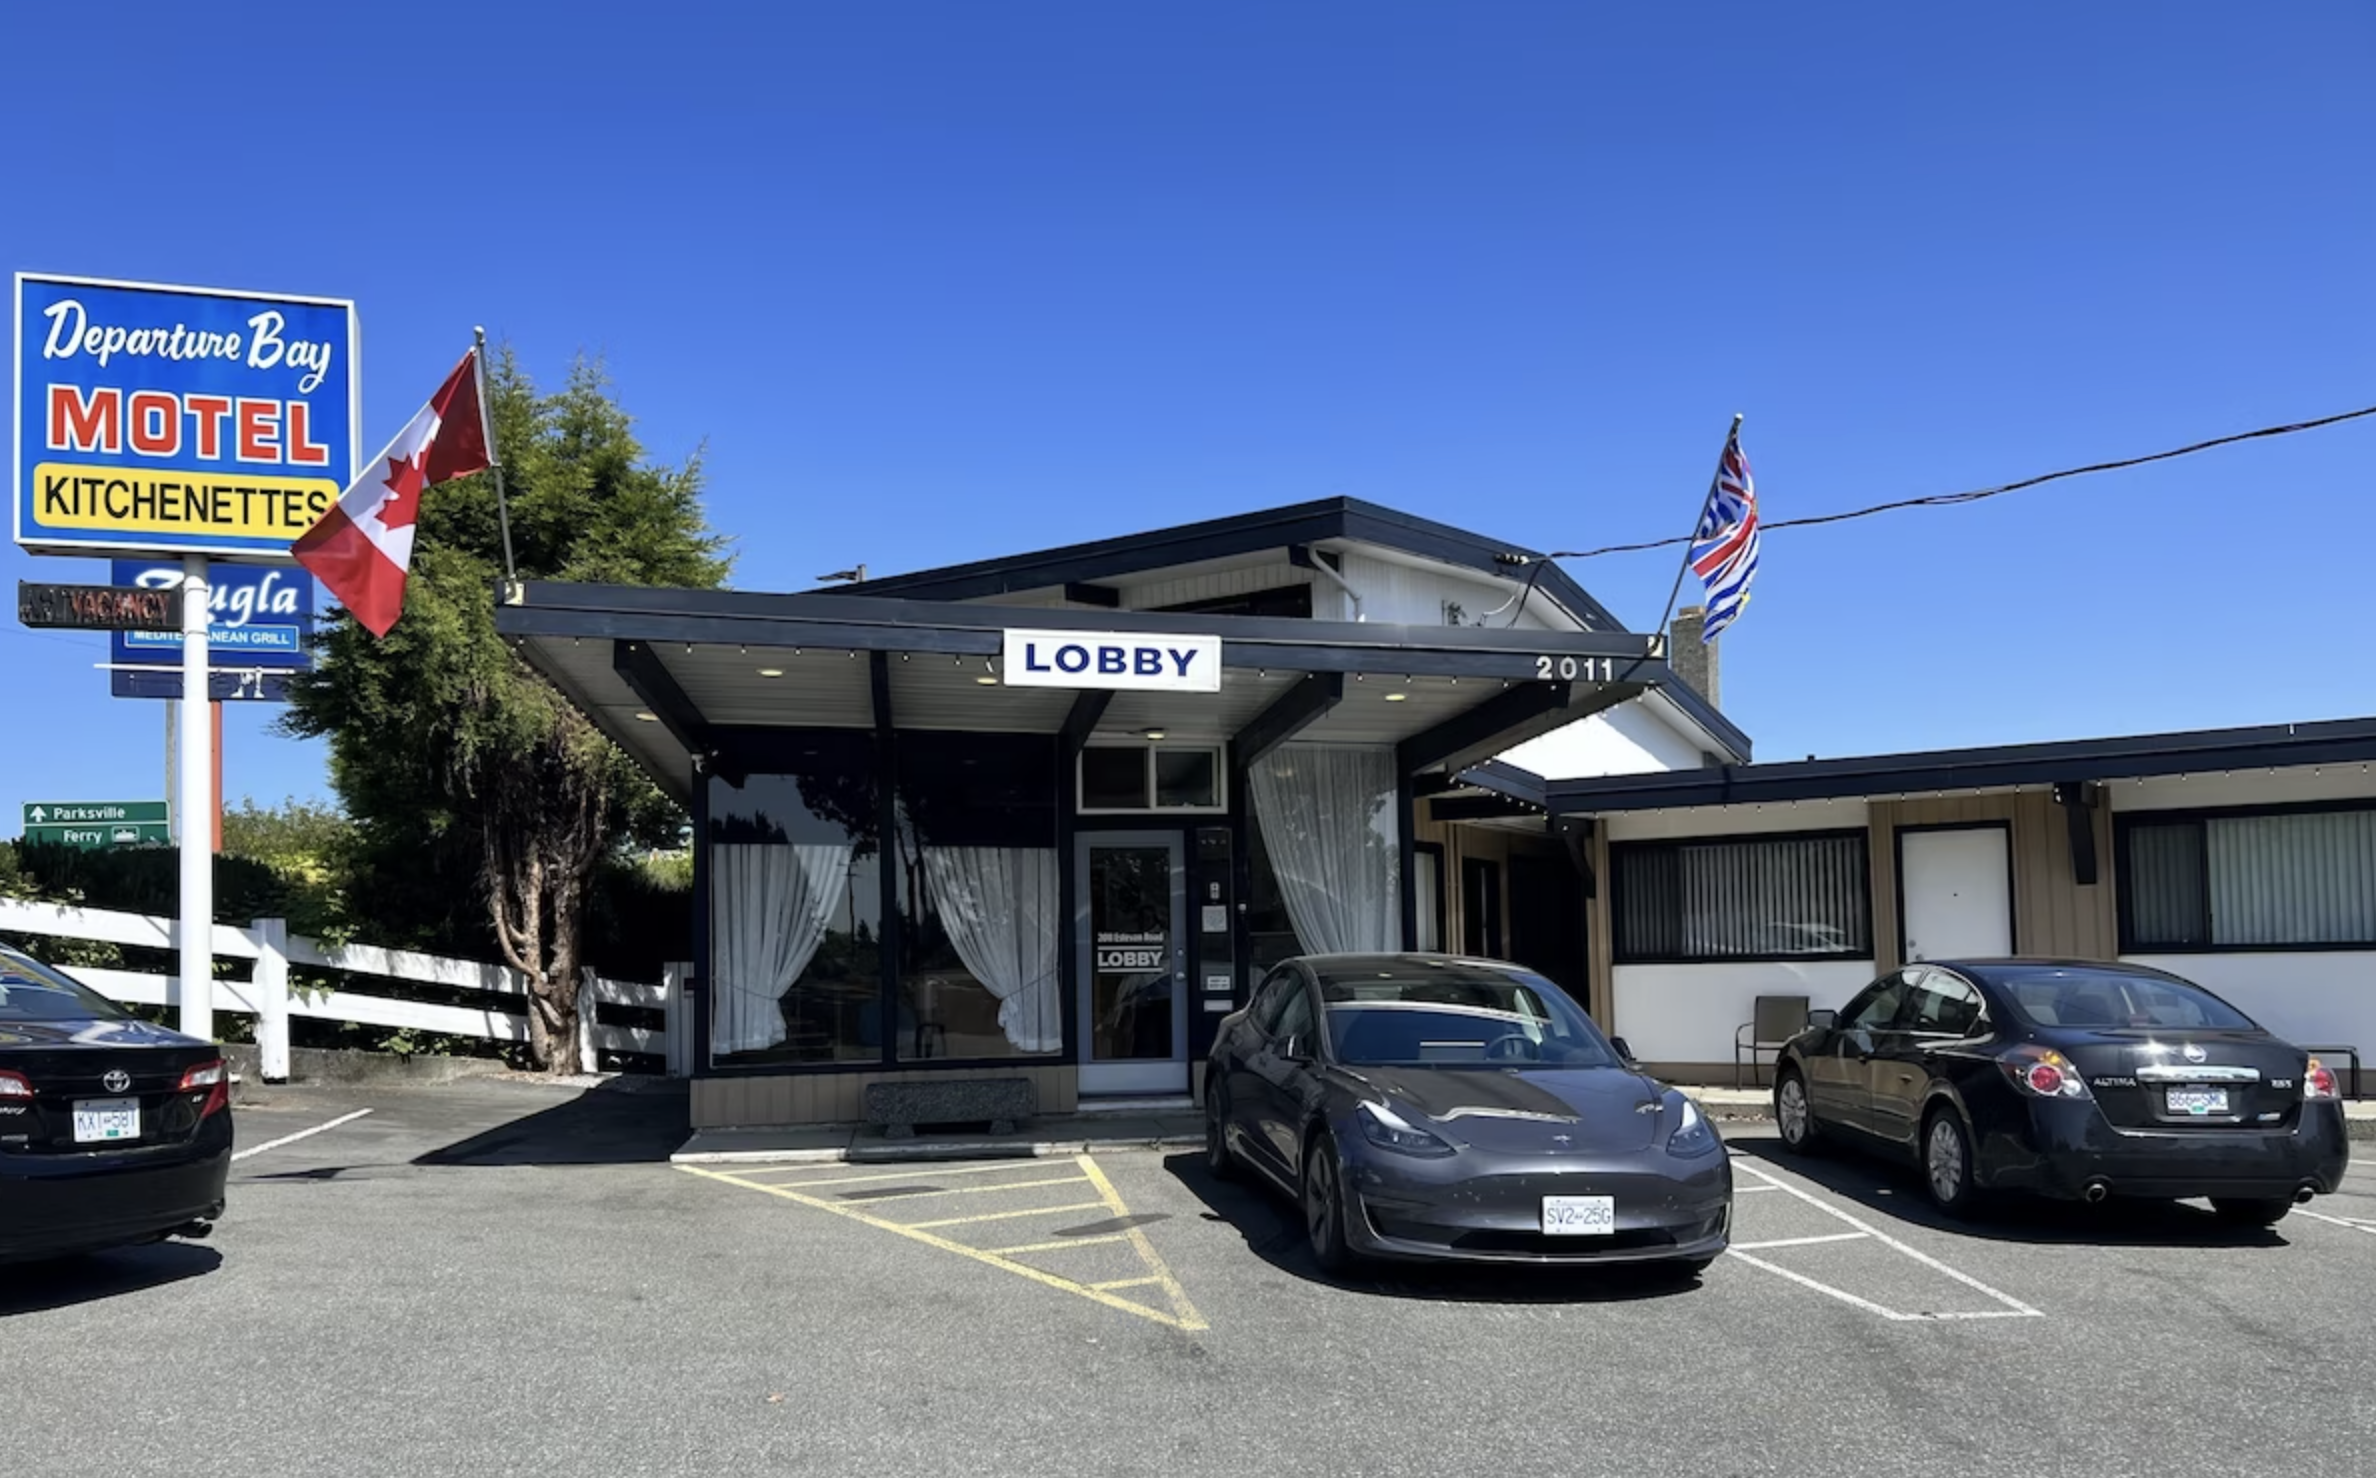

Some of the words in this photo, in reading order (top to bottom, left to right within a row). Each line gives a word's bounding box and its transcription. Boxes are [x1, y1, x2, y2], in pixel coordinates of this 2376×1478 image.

[43, 299, 241, 368] Departure
[247, 311, 331, 393] Bay
[47, 383, 329, 467] MOTEL
[45, 475, 328, 527] KITCHENETTES
[70, 589, 170, 621] VACANCY
[135, 568, 299, 628] ugla
[133, 629, 248, 643] MEDITENEAN
[251, 632, 290, 645] GRILL
[1026, 643, 1198, 677] LOBBY
[1536, 655, 1612, 682] 2011
[53, 806, 126, 820] Parksville
[63, 829, 103, 845] Ferry
[1097, 951, 1163, 967] LOBBY
